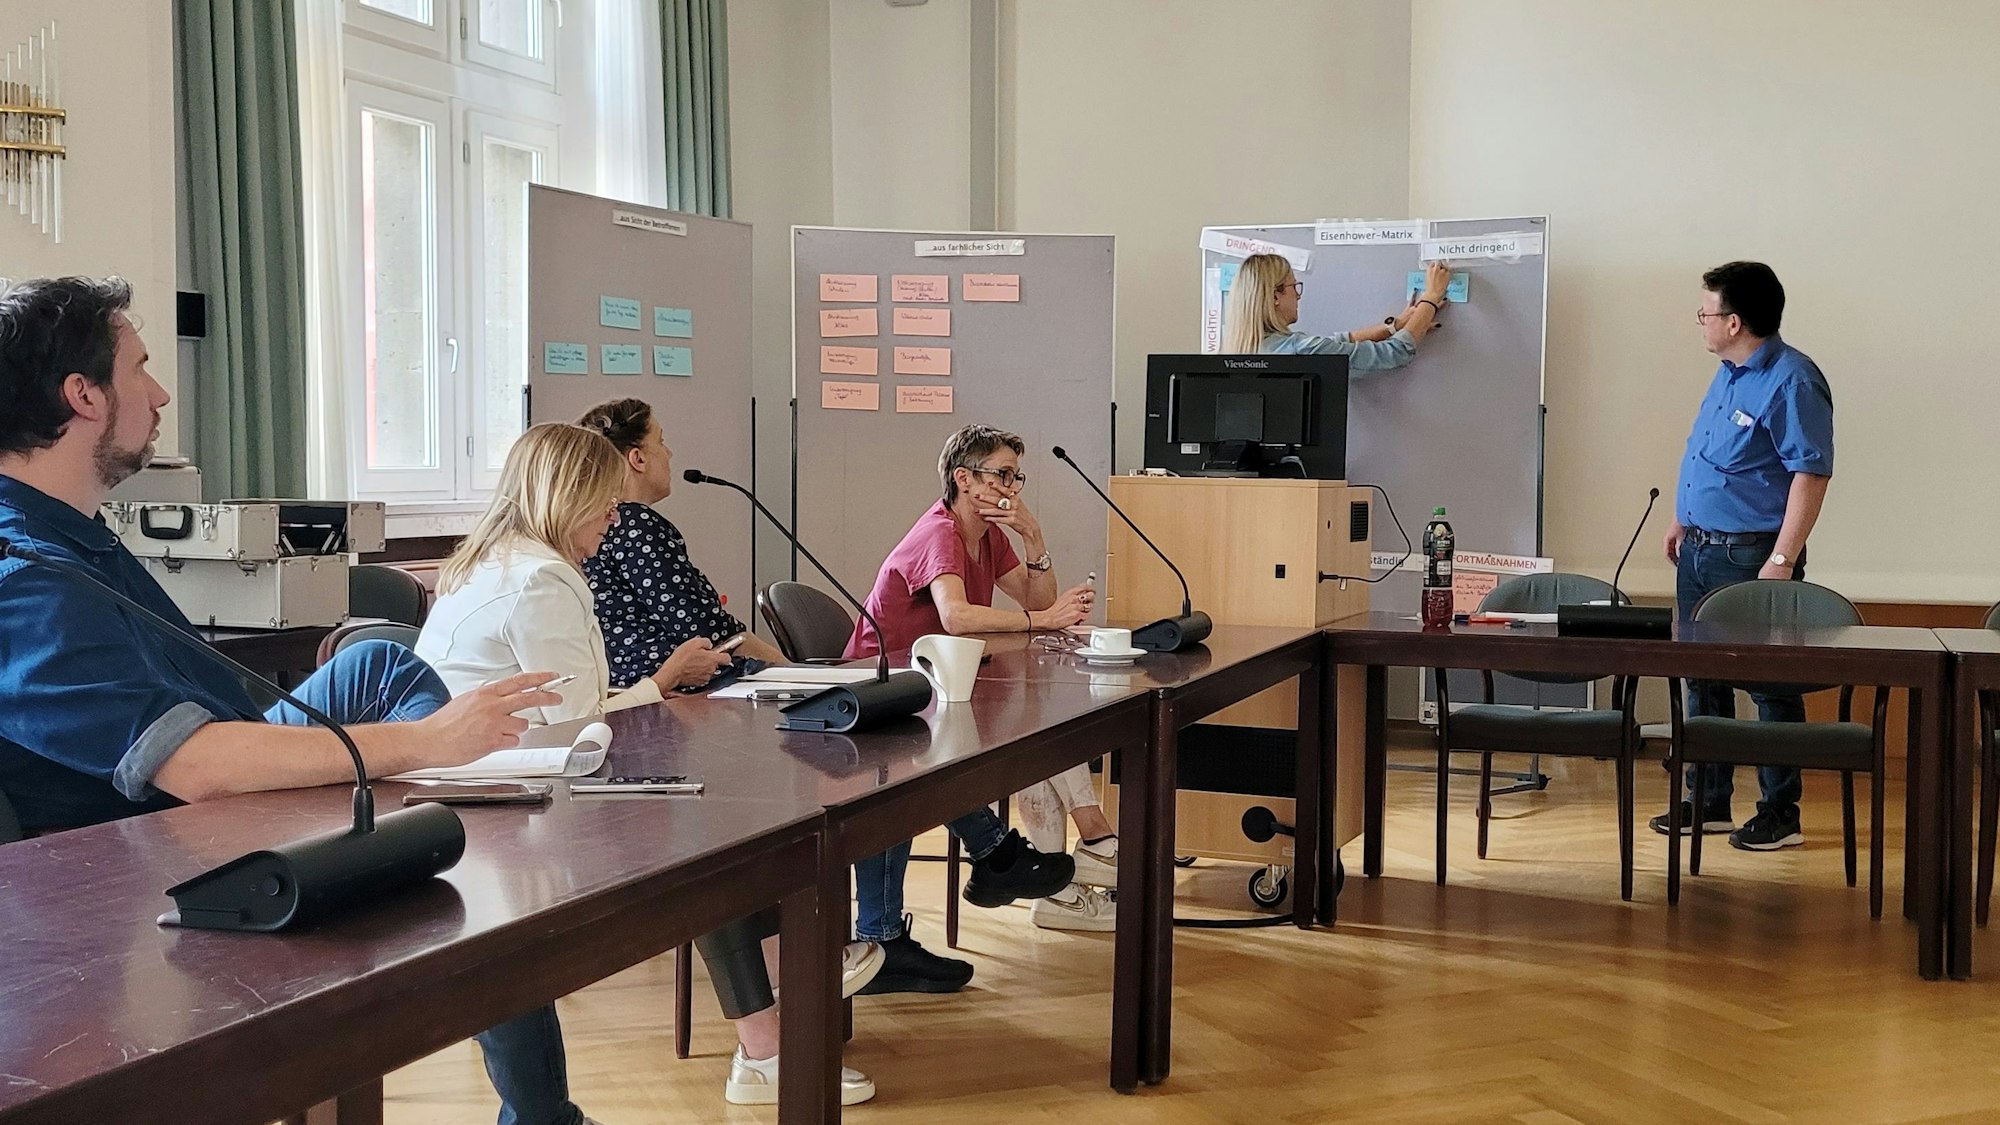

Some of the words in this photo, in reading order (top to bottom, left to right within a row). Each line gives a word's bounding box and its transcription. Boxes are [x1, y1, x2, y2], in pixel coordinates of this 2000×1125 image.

[1320, 230, 1413, 241] Eisenhower-Matrix
[986, 243, 1005, 251] Sicht
[1226, 238, 1276, 255] DRINGEND
[1438, 244, 1466, 254] Nicht
[1468, 241, 1515, 253] dringend
[1208, 309, 1217, 352] WICHTIG
[1223, 359, 1269, 369] ViewSonic
[1453, 554, 1537, 569] ORTMAßNAHMEN
